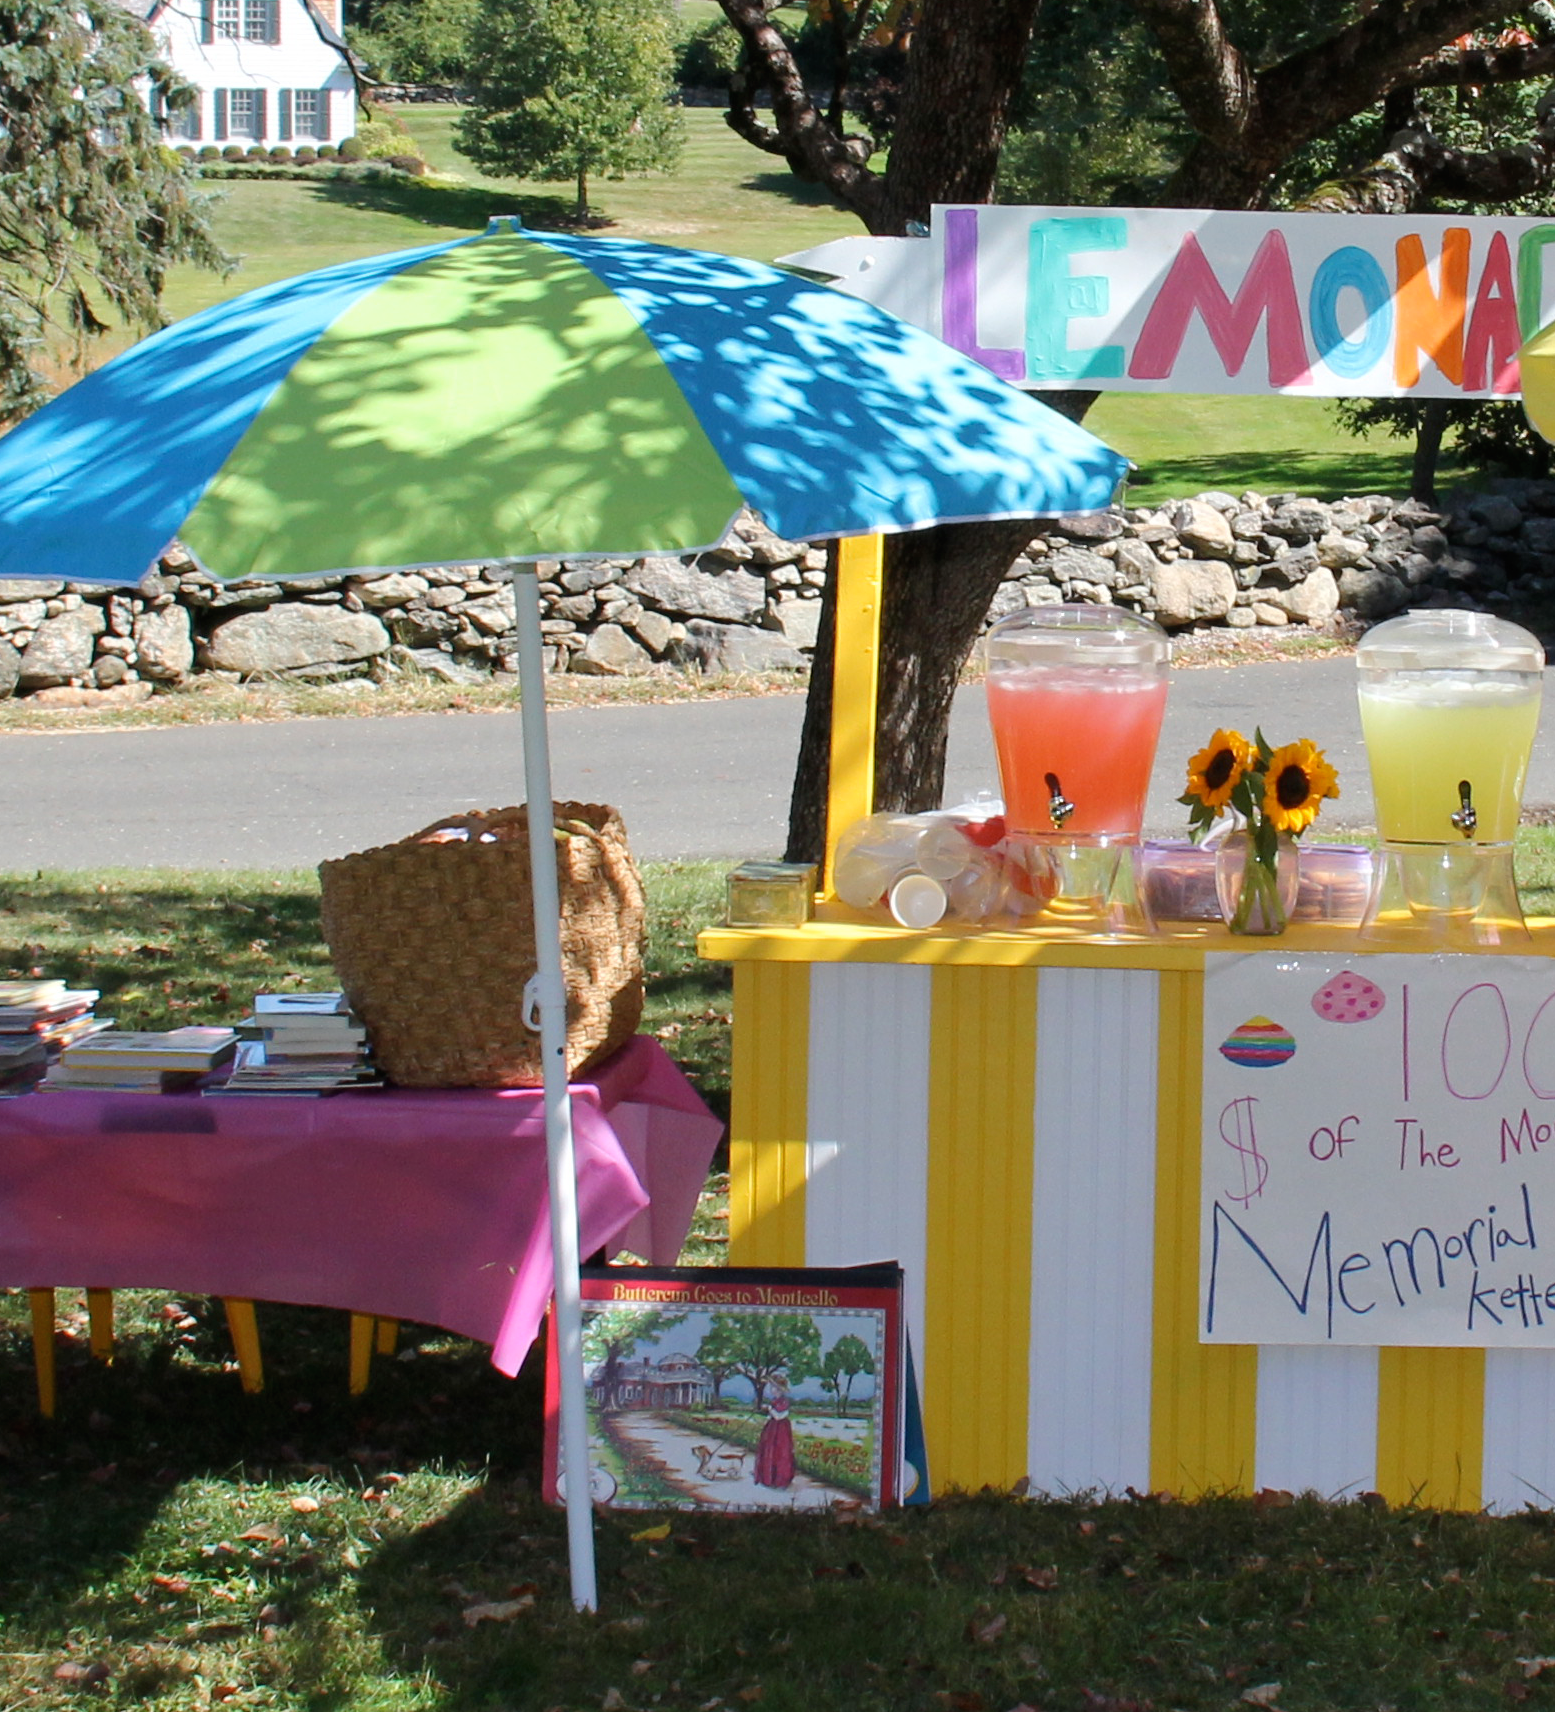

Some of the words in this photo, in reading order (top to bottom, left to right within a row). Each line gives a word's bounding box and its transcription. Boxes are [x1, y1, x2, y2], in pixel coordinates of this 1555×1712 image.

[1394, 1118, 1462, 1170] The
[1206, 1182, 1538, 1340] Memorial
[612, 1282, 691, 1304] Buttercup
[694, 1285, 733, 1304] Goes
[736, 1288, 751, 1304] to
[755, 1286, 839, 1307] Monticello
